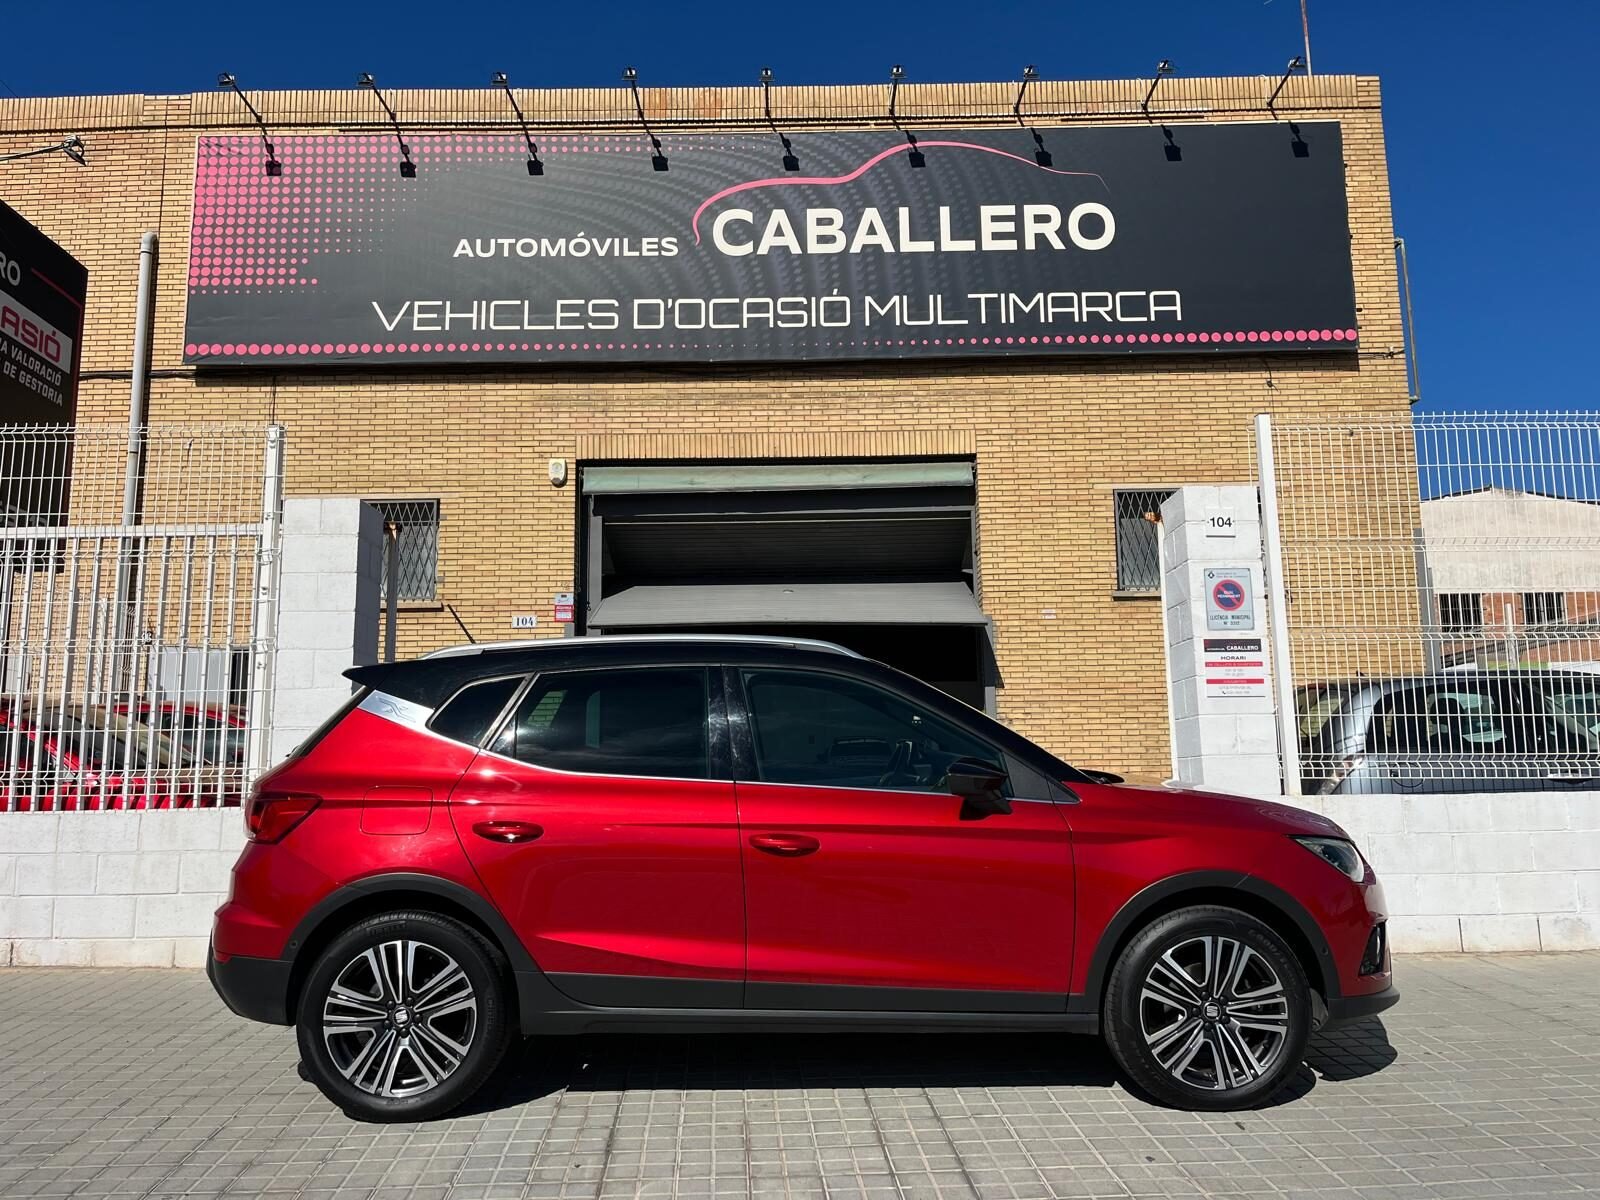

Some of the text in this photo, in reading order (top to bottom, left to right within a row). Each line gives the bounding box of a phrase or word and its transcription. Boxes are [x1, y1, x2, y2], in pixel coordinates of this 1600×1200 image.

[453, 203, 1116, 258] AUTOMÓVILES CABALLERO
[371, 289, 1182, 332] VEHICLES D'OCASIÓ MULTIMARCA
[1, 305, 60, 363] ASIÓ
[3, 360, 63, 407] DE GESTORIA
[11, 344, 62, 387] VALORACIÓ
[1209, 516, 1232, 527] 104
[517, 616, 534, 627] 104
